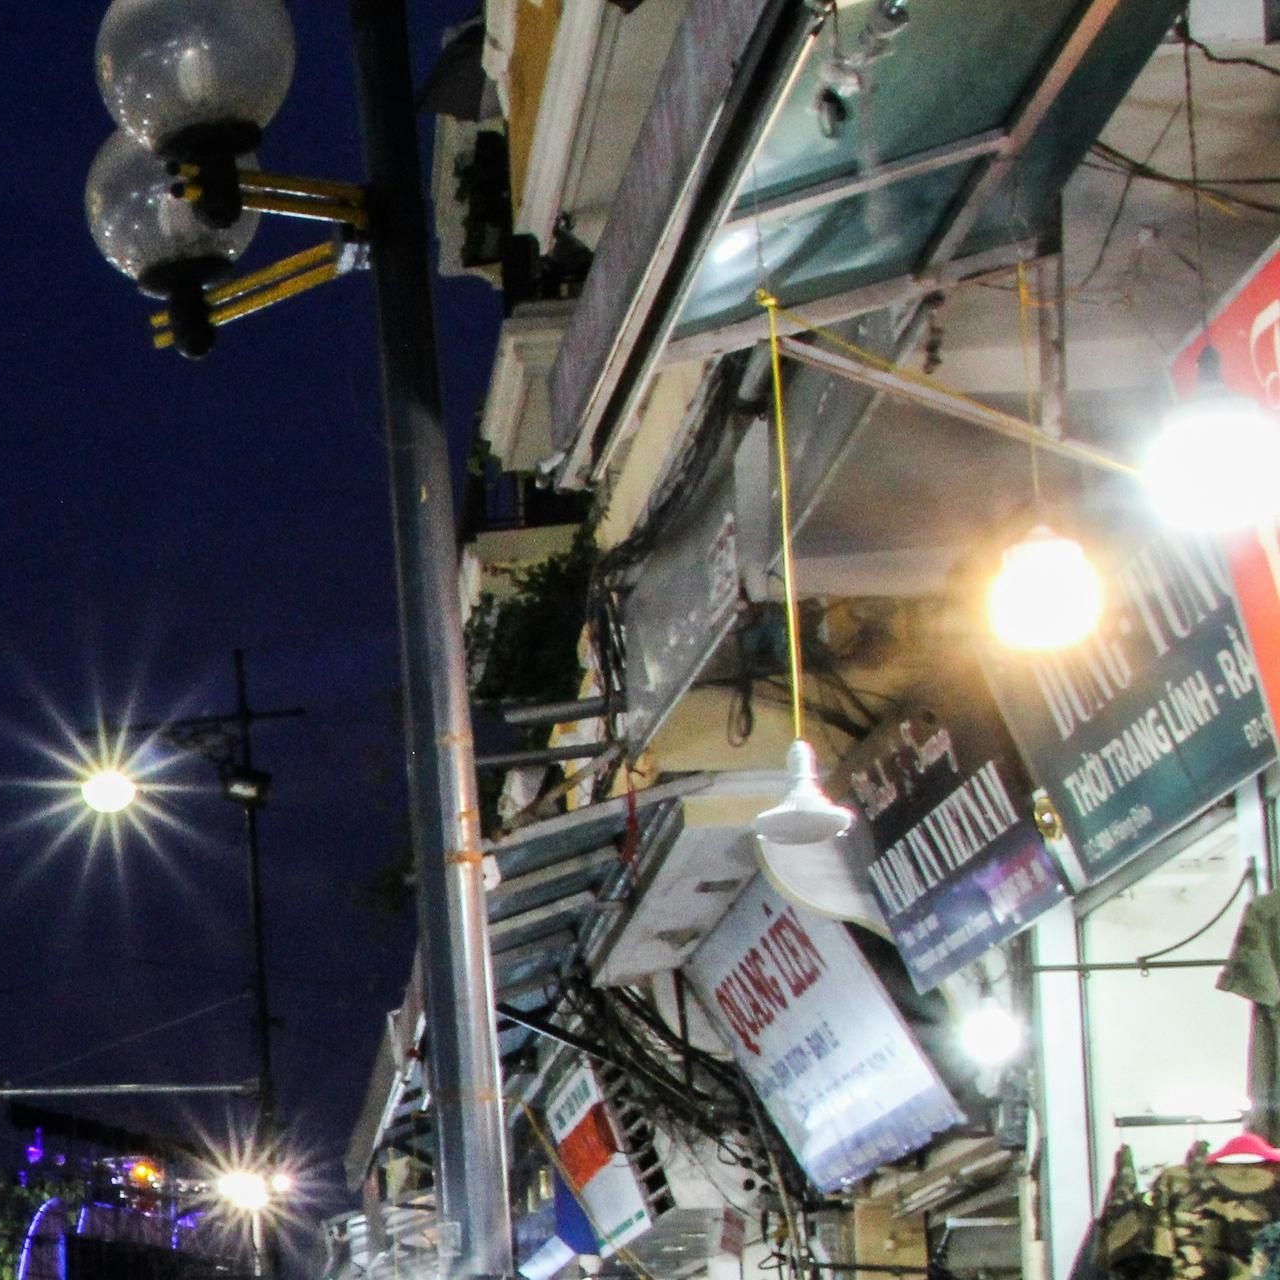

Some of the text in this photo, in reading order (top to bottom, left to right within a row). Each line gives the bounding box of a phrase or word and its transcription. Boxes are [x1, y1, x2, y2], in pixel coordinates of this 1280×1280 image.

[1101, 707, 1174, 789] TRANG
[867, 838, 928, 919] MADE
[922, 760, 1020, 871] VIETNAM
